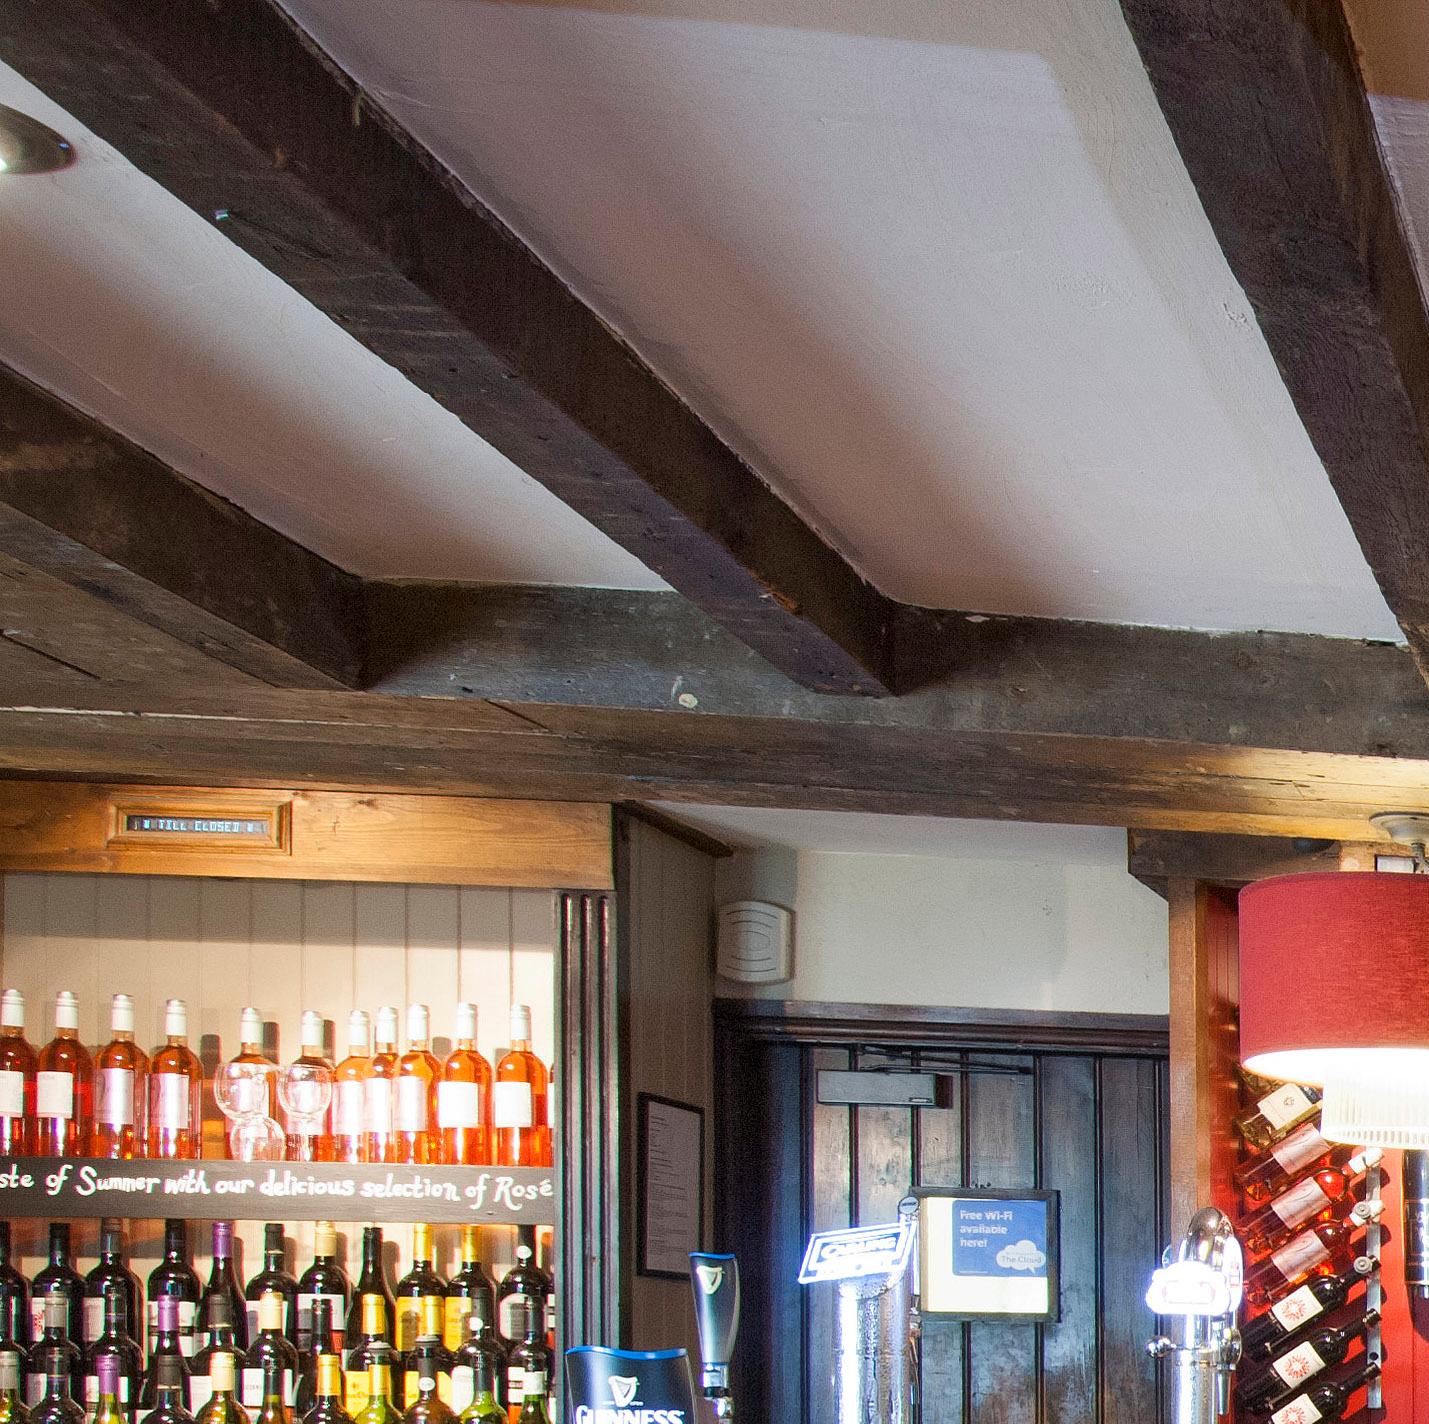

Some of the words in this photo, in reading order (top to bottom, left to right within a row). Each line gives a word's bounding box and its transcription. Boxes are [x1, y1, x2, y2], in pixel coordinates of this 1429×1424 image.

[194, 821, 240, 833] CLOSED
[45, 1164, 73, 1196] of
[75, 1166, 162, 1196] Summer
[164, 1169, 210, 1195] with
[215, 1179, 255, 1195] our
[259, 1169, 356, 1197] delicious
[360, 1173, 461, 1201] selection
[465, 1174, 491, 1210] of
[494, 1176, 554, 1211] Rosé
[960, 1210, 982, 1220] Free
[984, 1210, 1013, 1220] Wi-Fi
[960, 1224, 1008, 1234] available
[960, 1237, 988, 1248] here!
[1001, 1254, 1016, 1264] The
[1018, 1255, 1042, 1264] Cloud
